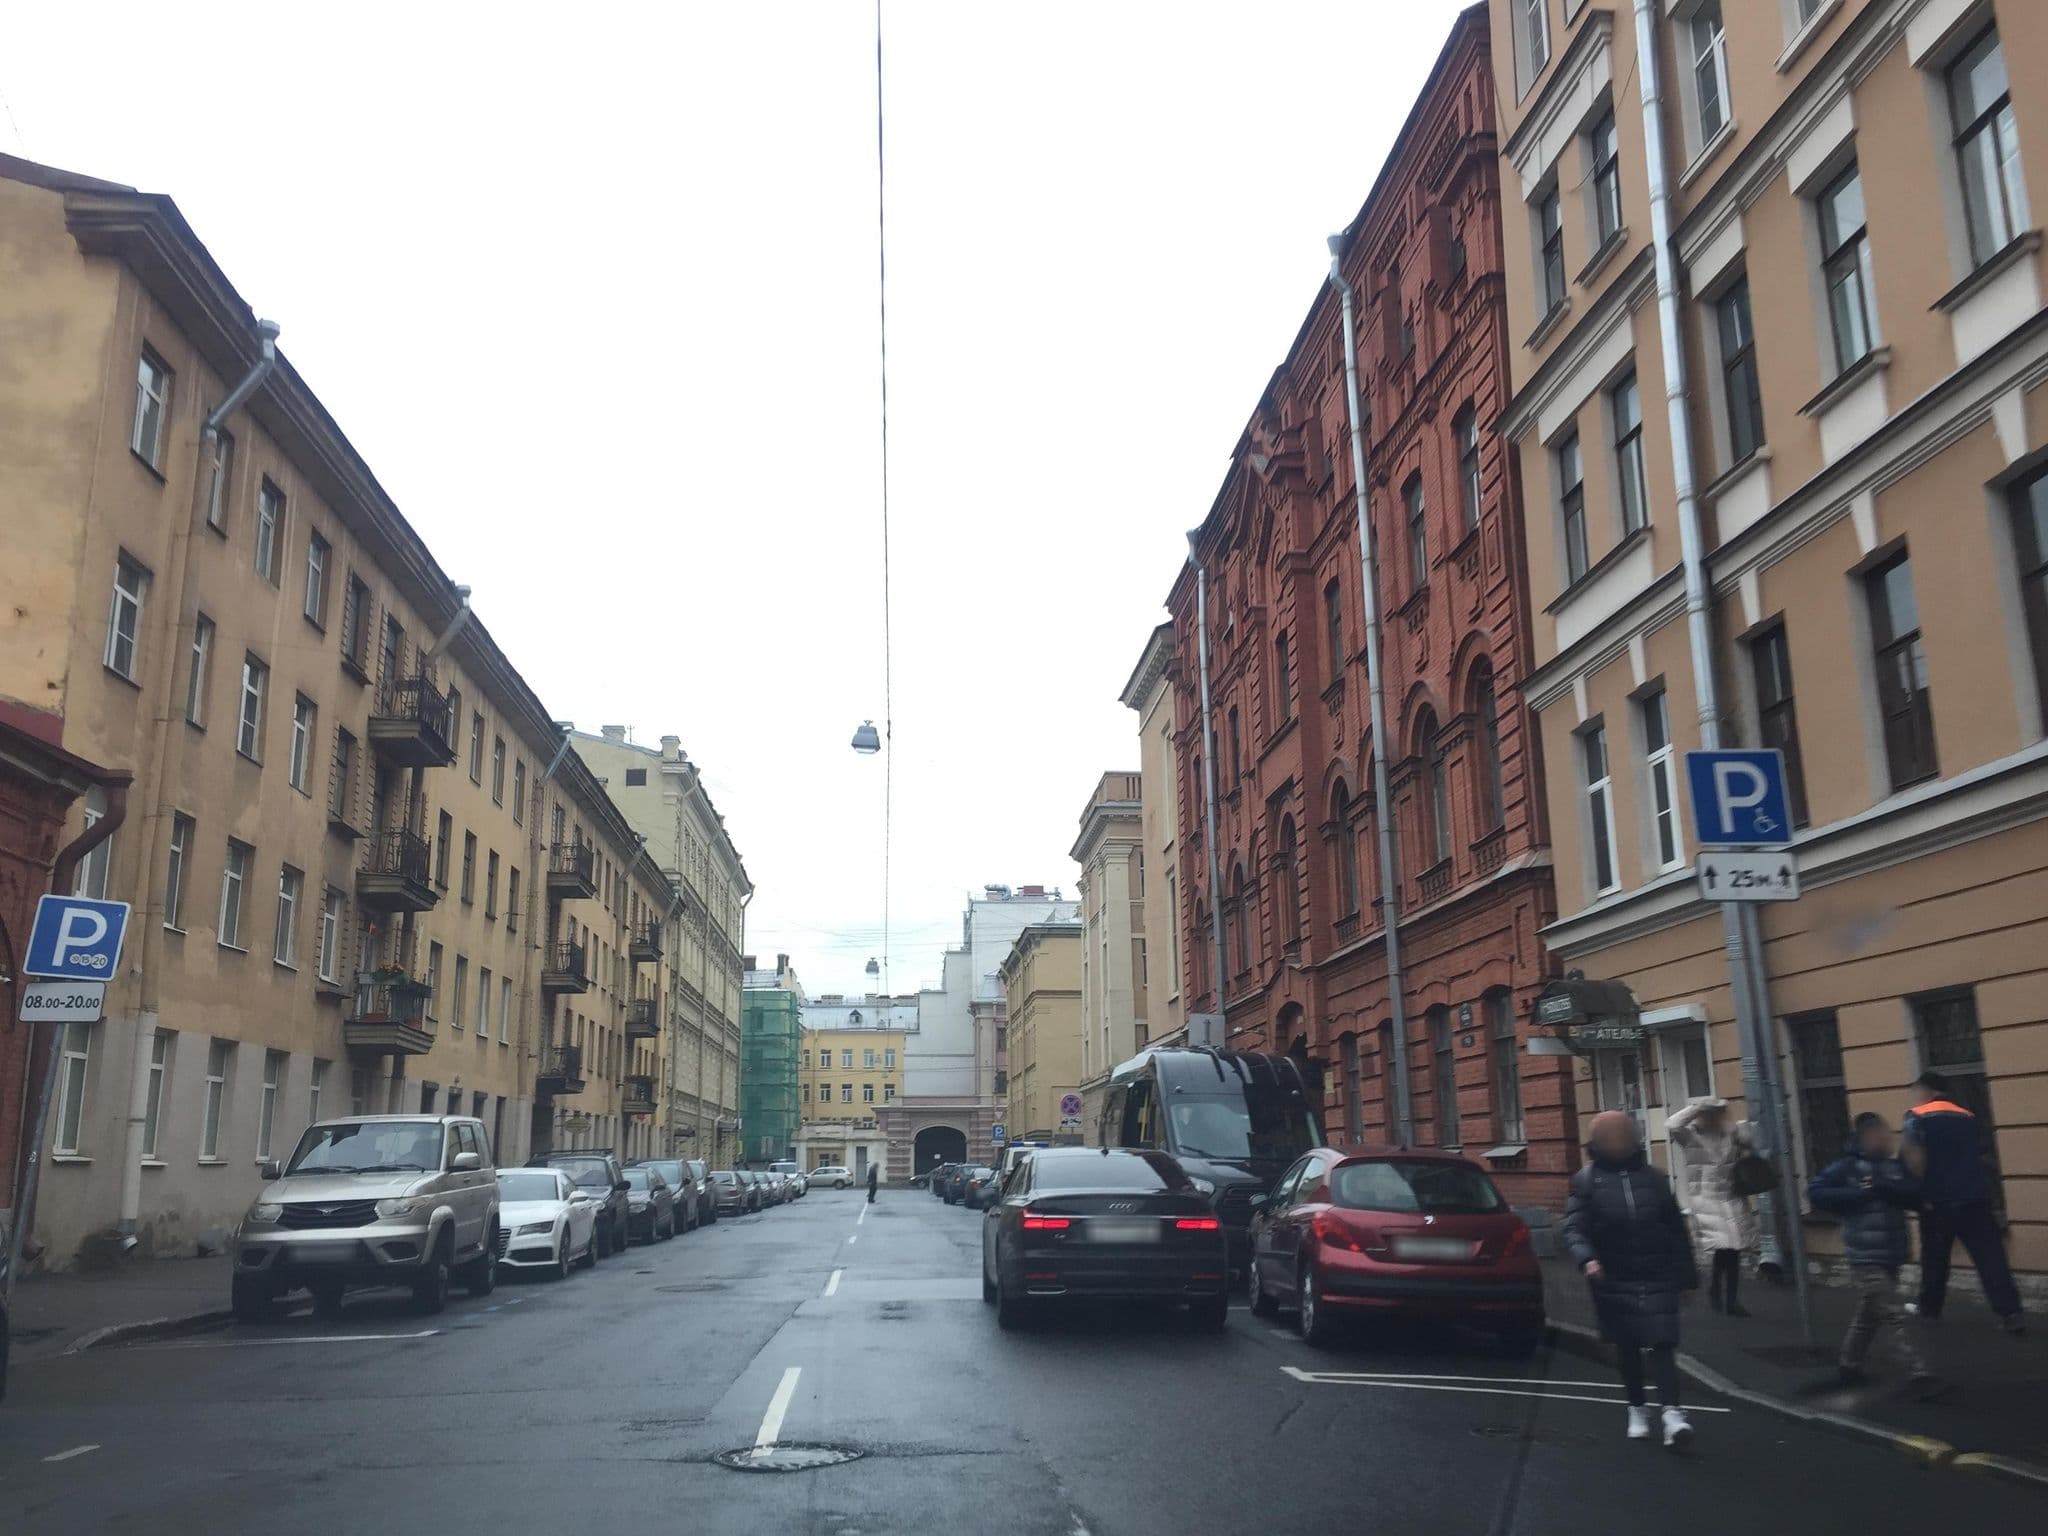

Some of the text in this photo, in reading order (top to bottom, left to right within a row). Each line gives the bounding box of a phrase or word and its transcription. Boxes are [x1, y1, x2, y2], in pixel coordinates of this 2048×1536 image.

[1712, 761, 1768, 833] P
[52, 907, 107, 967] P
[92, 956, 106, 967] 20
[25, 995, 100, 1009] 08.00-20.00
